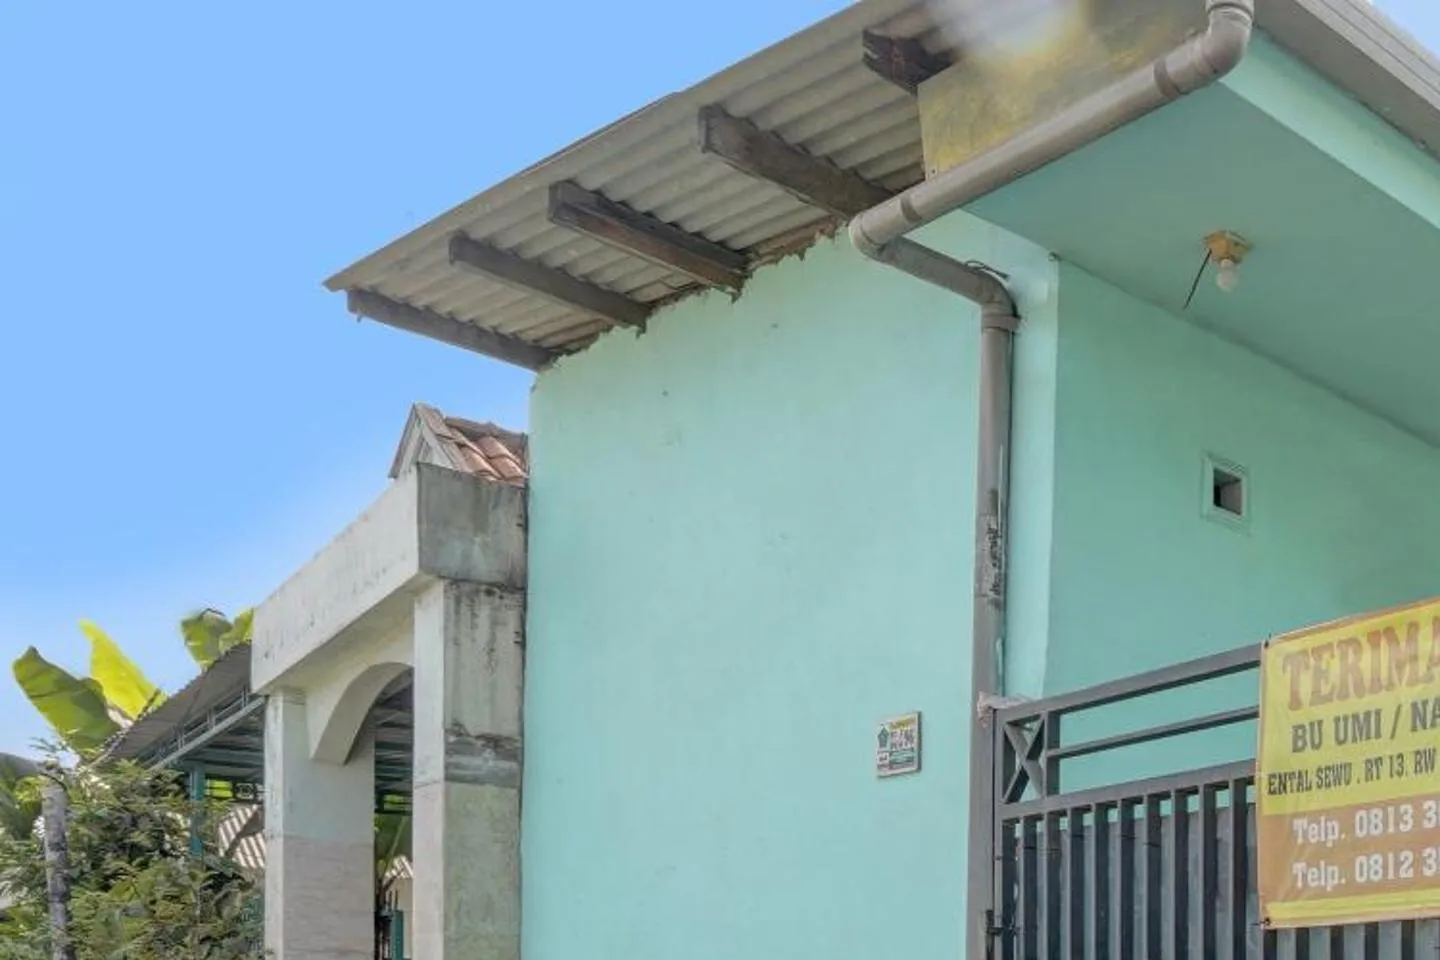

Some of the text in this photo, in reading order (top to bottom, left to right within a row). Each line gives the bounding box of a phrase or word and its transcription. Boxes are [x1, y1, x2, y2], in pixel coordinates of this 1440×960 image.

[1291, 719, 1324, 754] BU
[1333, 709, 1383, 746] UMI
[1267, 769, 1313, 796] ENTAL
[1315, 763, 1353, 790] SEWU
[1364, 758, 1384, 784] RT
[1413, 749, 1437, 775] RW
[1292, 817, 1347, 848] Telp.
[1354, 804, 1414, 838] 0813
[1292, 862, 1347, 892] Telp.
[1354, 850, 1415, 883] 0812
